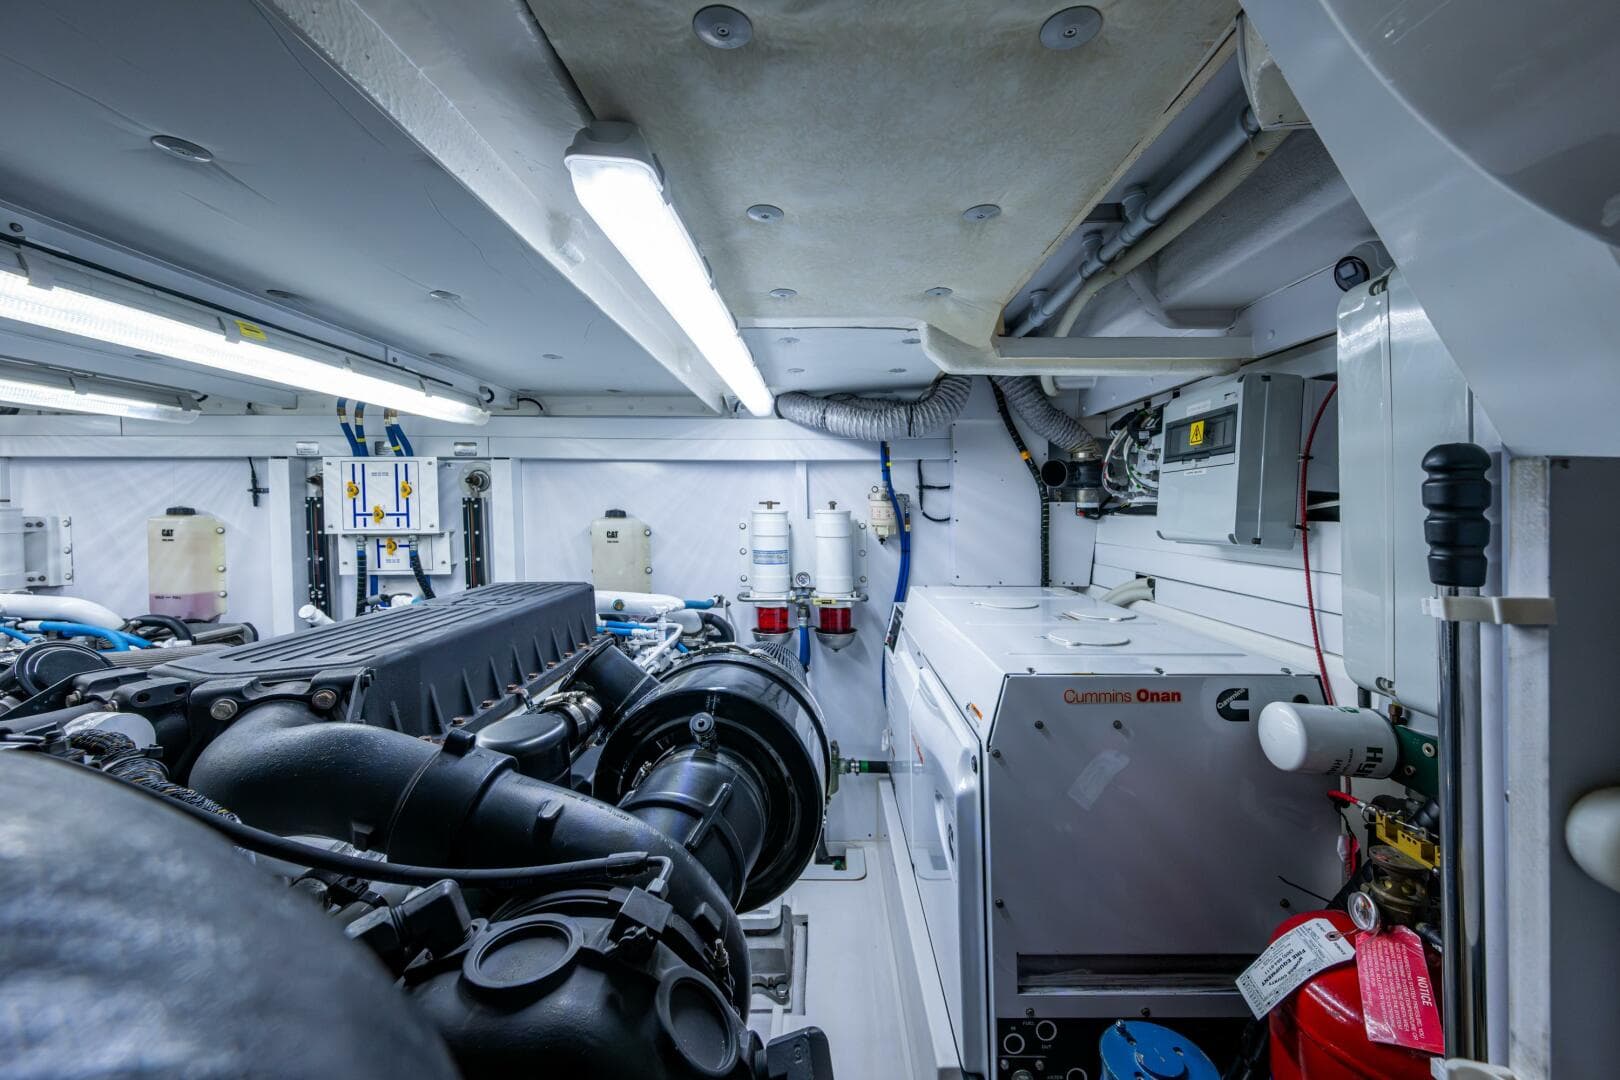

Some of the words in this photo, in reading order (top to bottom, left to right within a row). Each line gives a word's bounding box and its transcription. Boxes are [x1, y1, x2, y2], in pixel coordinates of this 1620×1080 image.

[161, 528, 174, 537] CAT
[606, 530, 619, 538] CAT
[1064, 689, 1132, 704] Cummins
[1136, 688, 1182, 703] Onan
[1217, 688, 1247, 710] Cummins
[1291, 948, 1306, 959] FIRE
[1261, 958, 1293, 986] EQUIPMENT
[1416, 976, 1433, 1006] NOTICE
